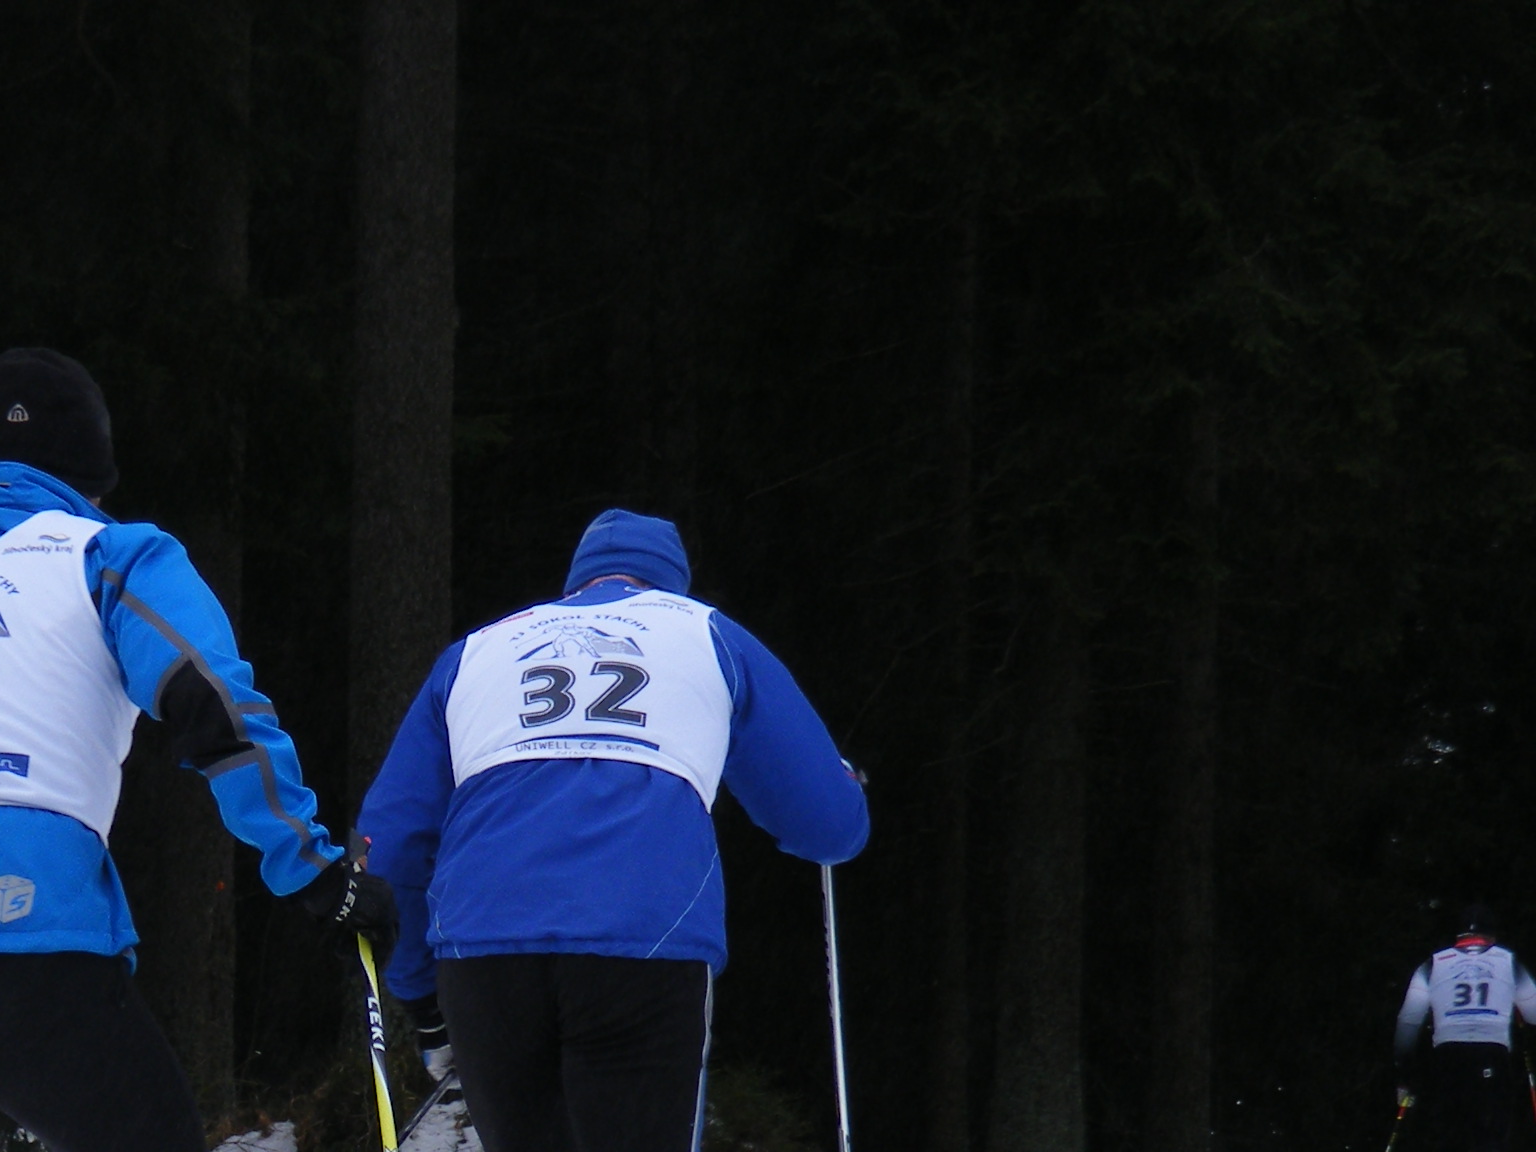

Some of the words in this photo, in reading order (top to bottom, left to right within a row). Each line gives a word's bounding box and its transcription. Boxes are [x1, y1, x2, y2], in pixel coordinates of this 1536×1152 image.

[529, 614, 585, 630] SOKOL
[594, 613, 650, 632] STACHY
[519, 661, 650, 728] 32
[515, 741, 573, 752] UNIWELL
[580, 741, 597, 750] CZ
[335, 879, 358, 922] LEKI
[1453, 982, 1490, 1007] 31
[367, 996, 386, 1052] LEKI
